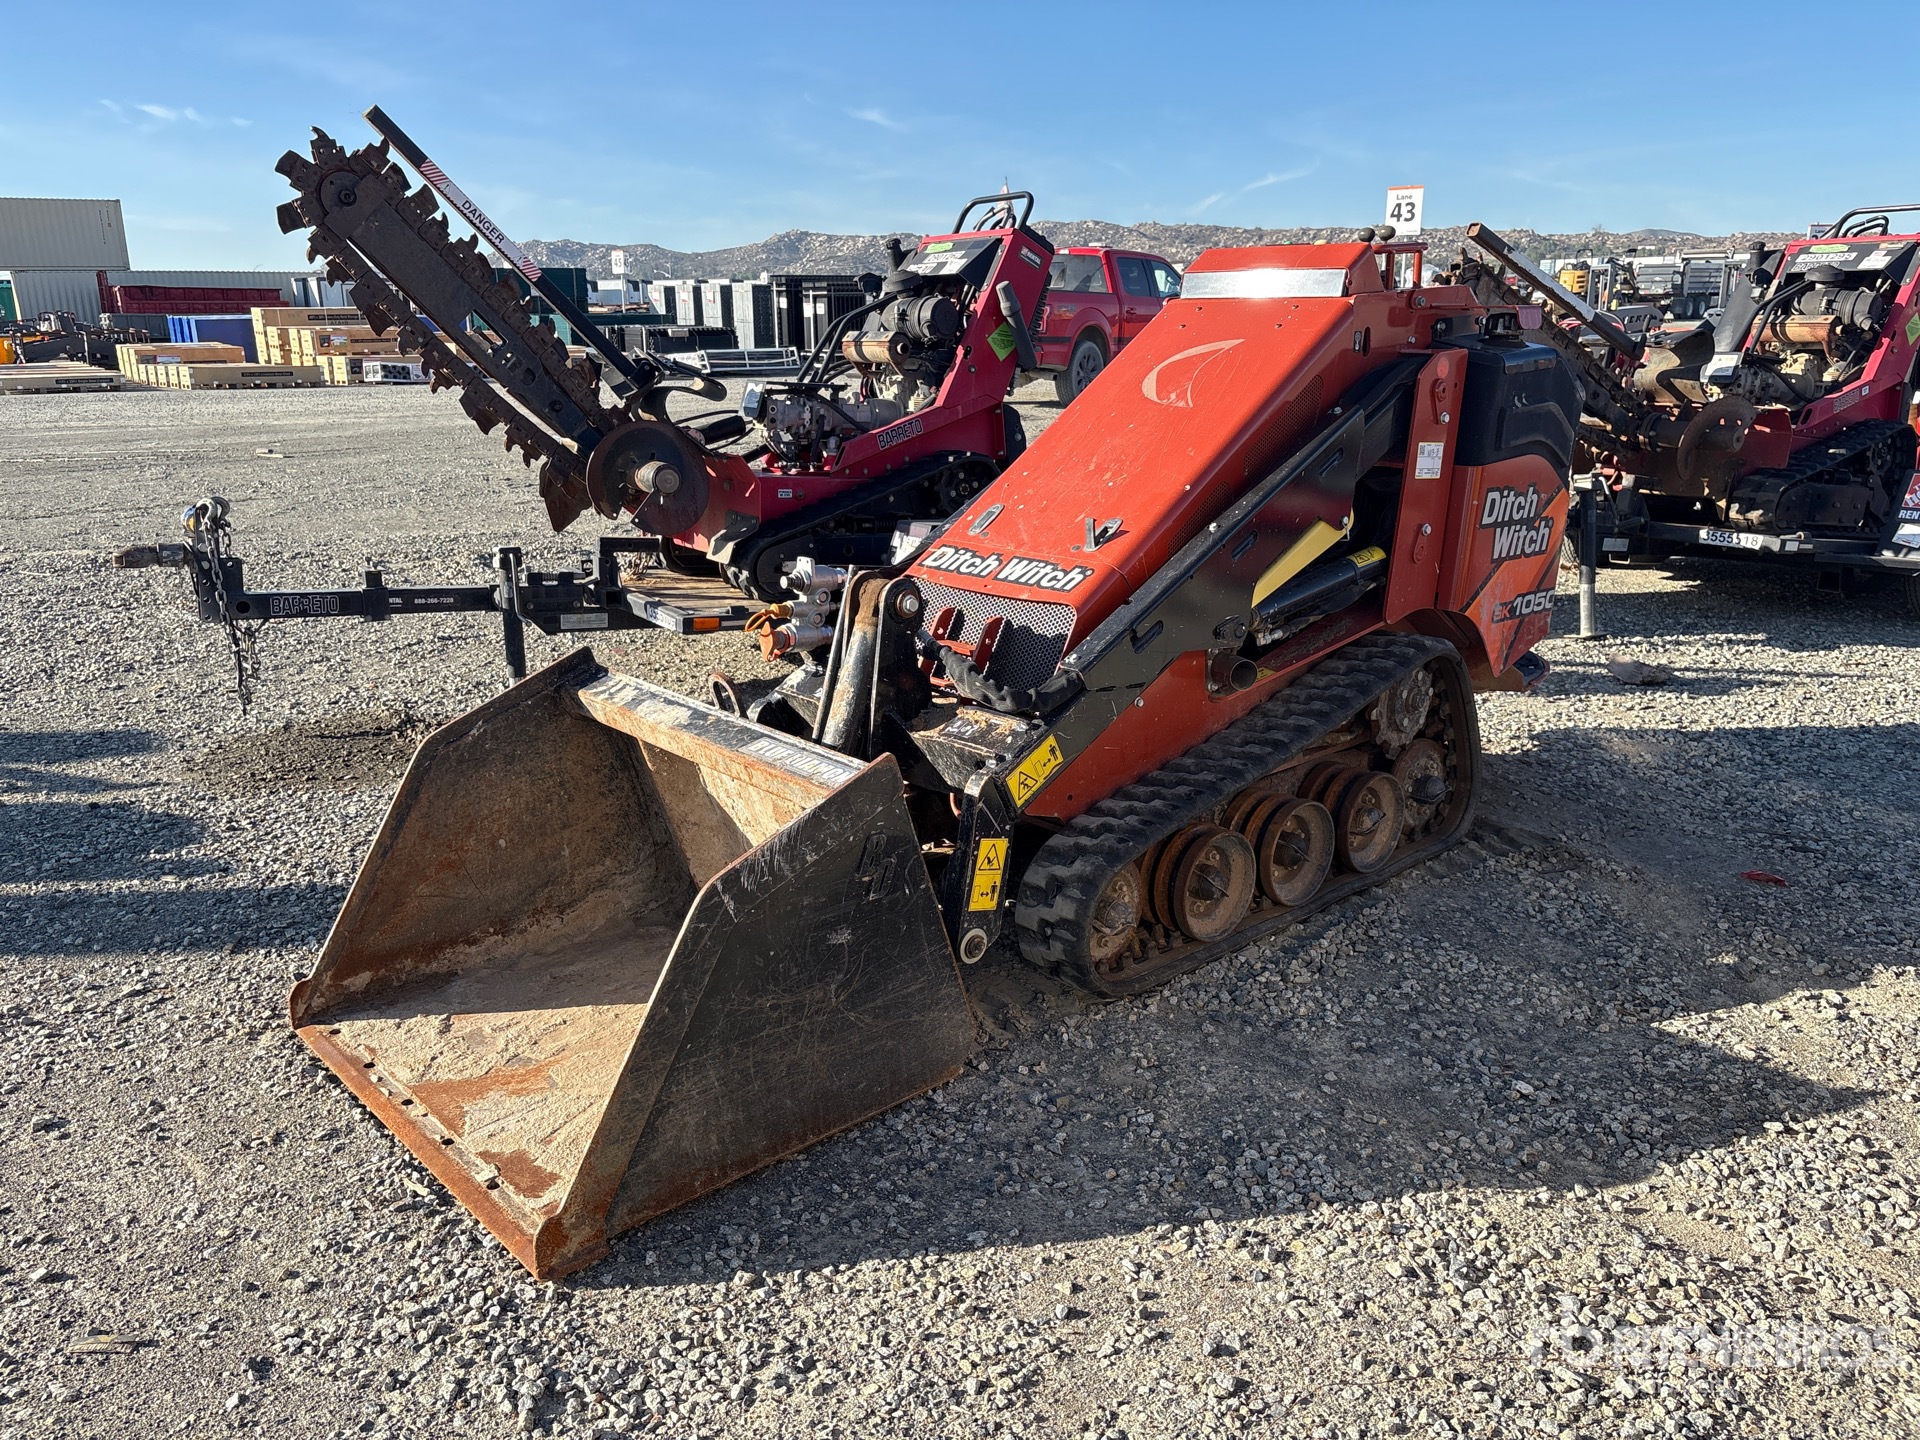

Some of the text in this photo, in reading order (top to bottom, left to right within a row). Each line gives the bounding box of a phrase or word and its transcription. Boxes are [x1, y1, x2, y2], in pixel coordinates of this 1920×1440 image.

[461, 200, 505, 244] DANGER
[1390, 202, 1416, 222] 43
[876, 418, 924, 450] BARRETO
[1481, 486, 1538, 525] Ditch
[1492, 520, 1550, 560] Witch
[921, 546, 1089, 591] Ditch Witch
[269, 595, 340, 616] BARRETO
